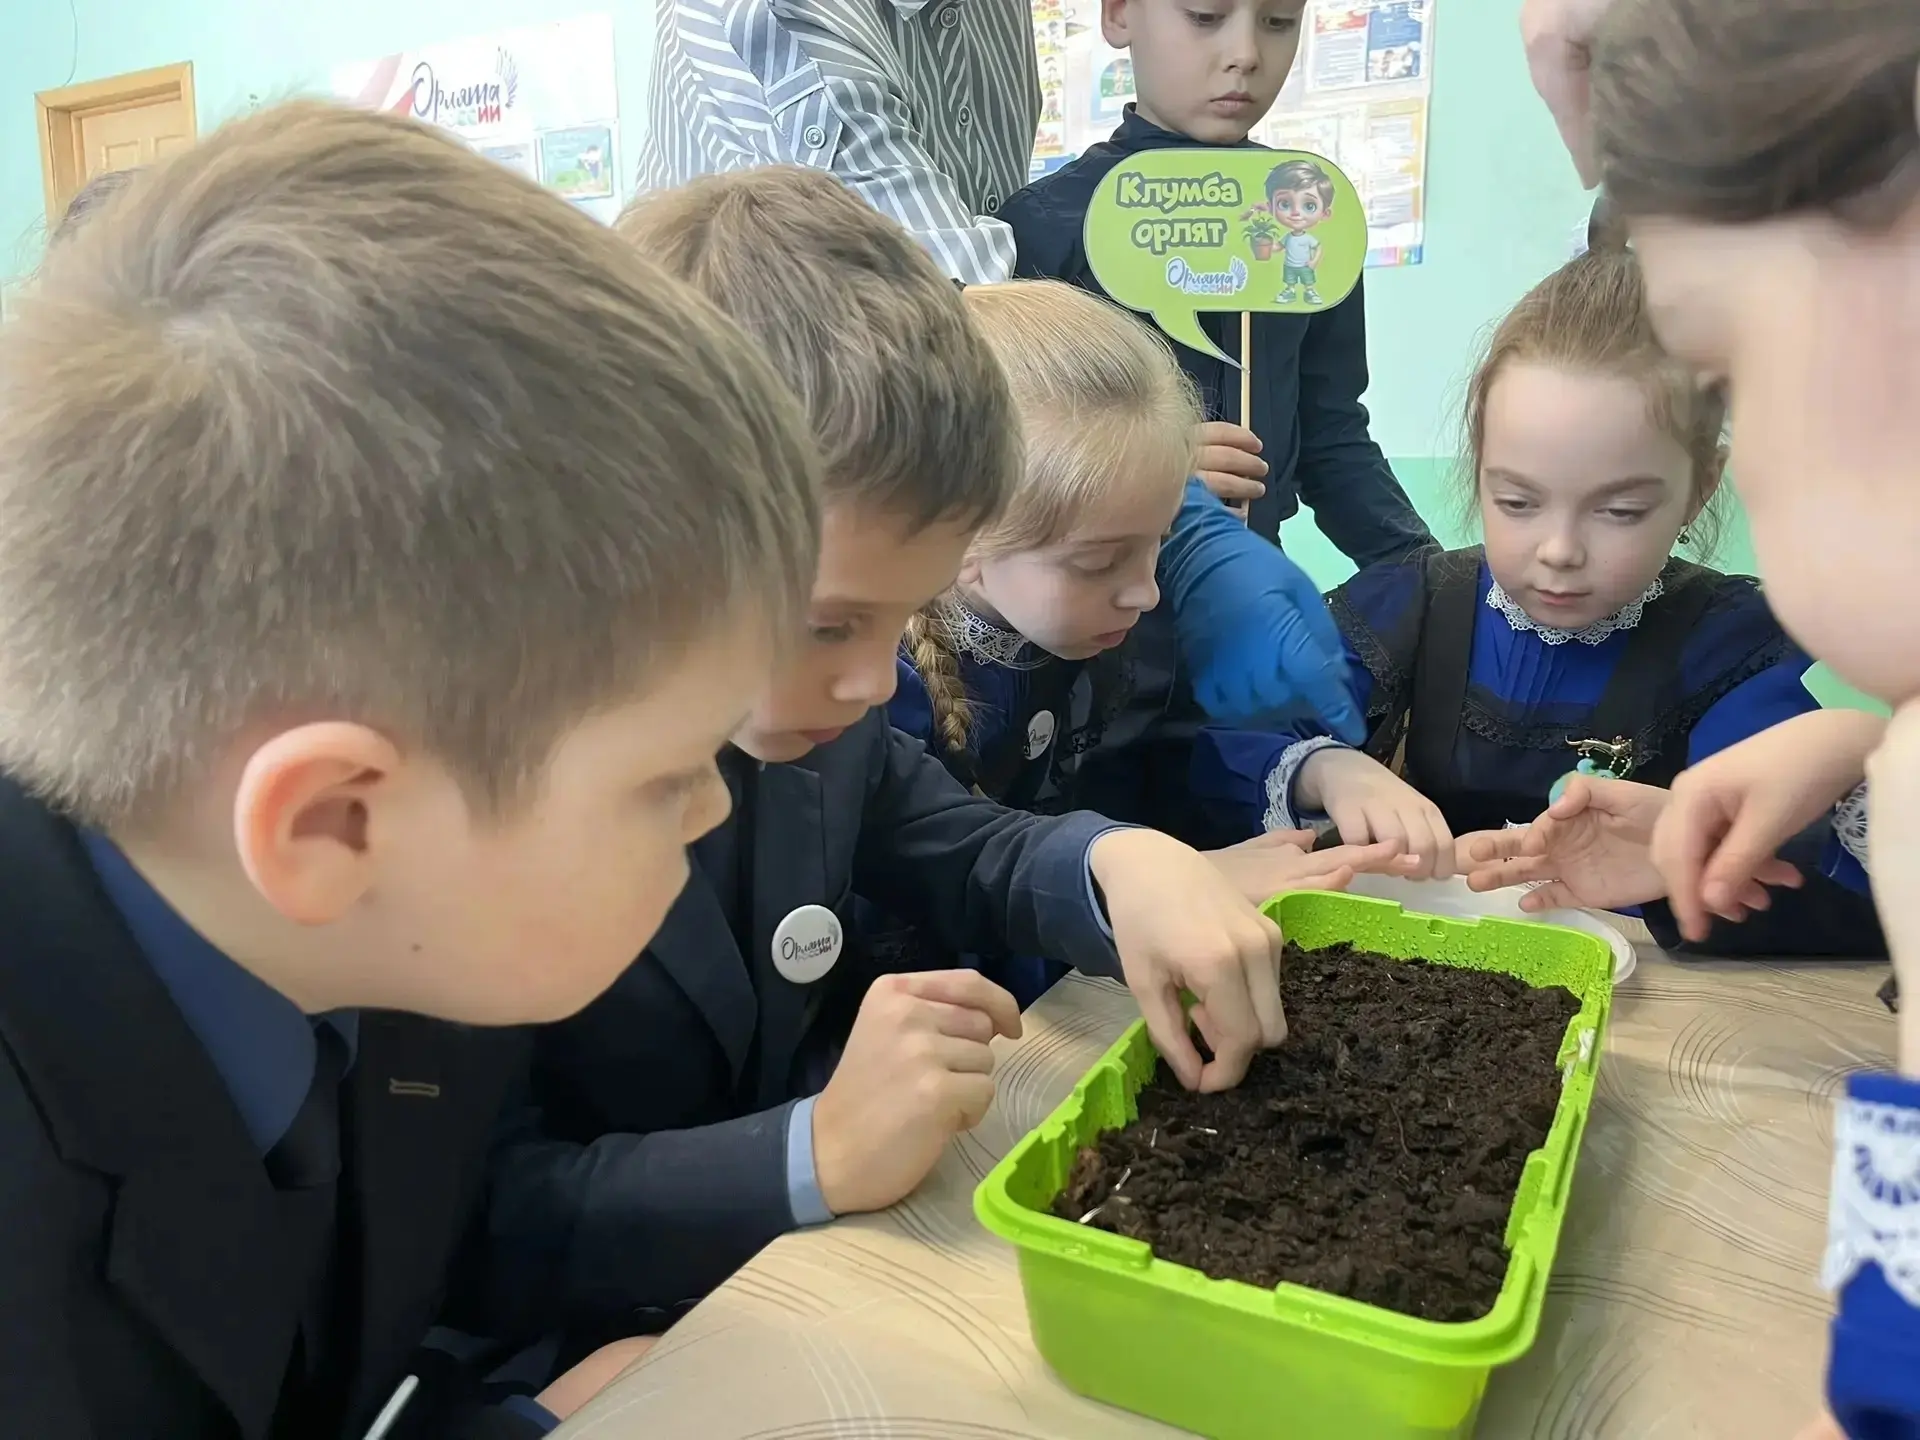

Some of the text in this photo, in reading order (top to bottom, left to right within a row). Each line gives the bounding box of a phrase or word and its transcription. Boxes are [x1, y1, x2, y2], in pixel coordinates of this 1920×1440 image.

[411, 61, 500, 124] Орлята
[1117, 173, 1241, 212] Клумба
[1132, 219, 1227, 254] орлят
[1168, 257, 1233, 289] Орлята
